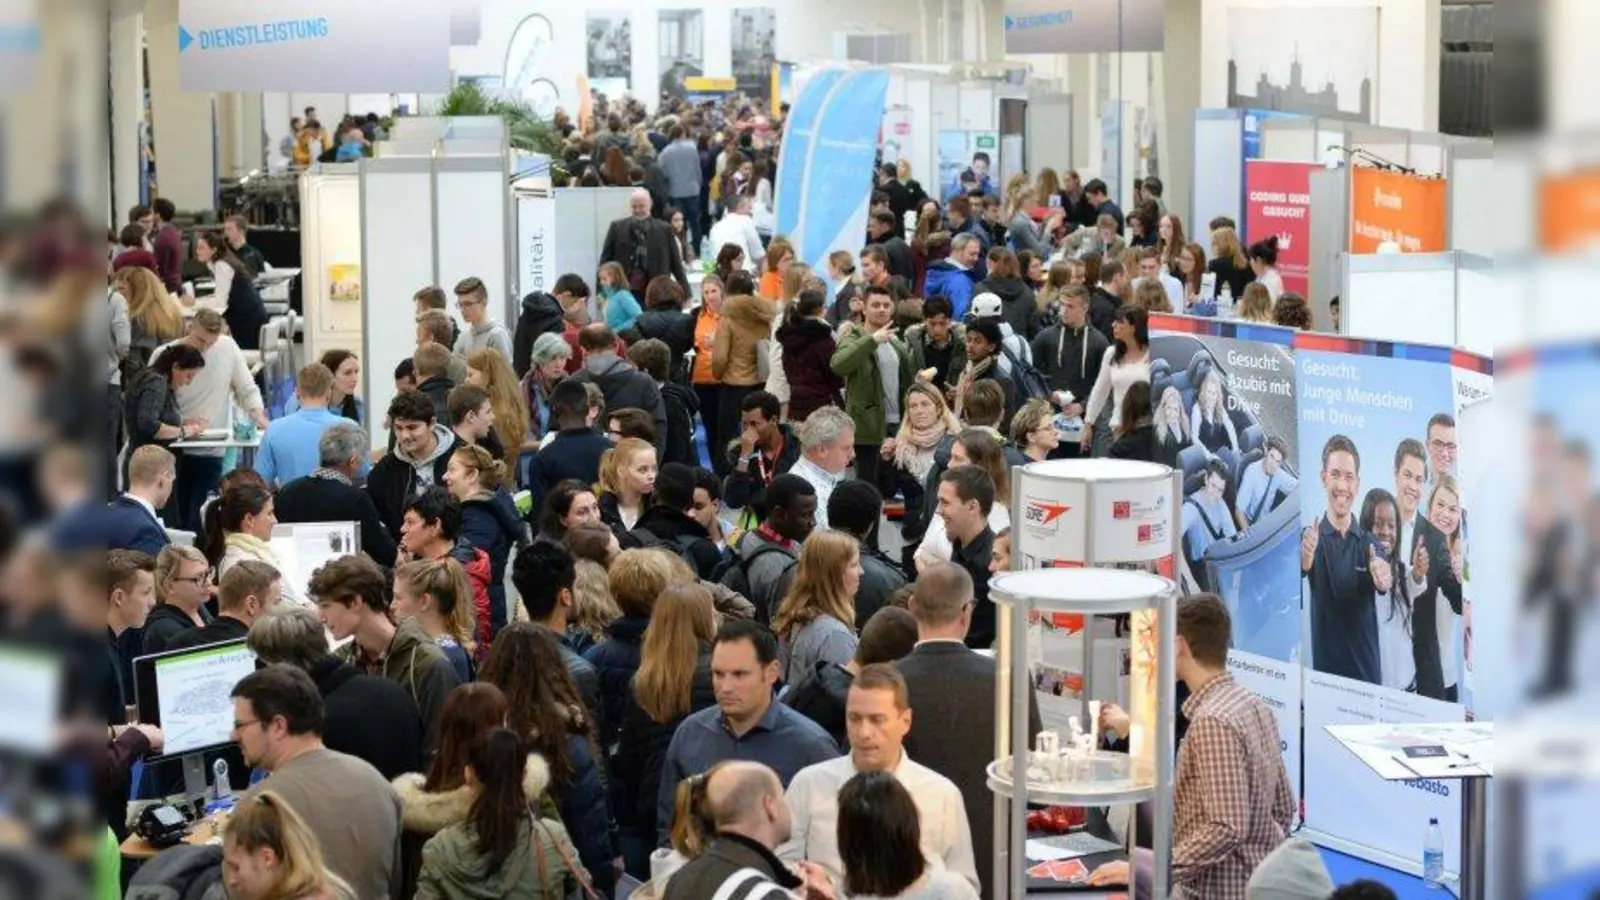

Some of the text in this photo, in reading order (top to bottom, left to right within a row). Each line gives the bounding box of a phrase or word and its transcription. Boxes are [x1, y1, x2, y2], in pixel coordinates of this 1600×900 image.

[199, 17, 328, 50] DIENSTLEISTUNG
[1262, 205, 1306, 218] GESUCHT
[530, 226, 544, 288] alität.
[1227, 374, 1292, 397] Azubis mit
[1302, 381, 1414, 411] Junge Menschen
[1227, 395, 1261, 415] Drive
[1303, 406, 1366, 428] mit Drive
[1399, 779, 1449, 796] ebasto
